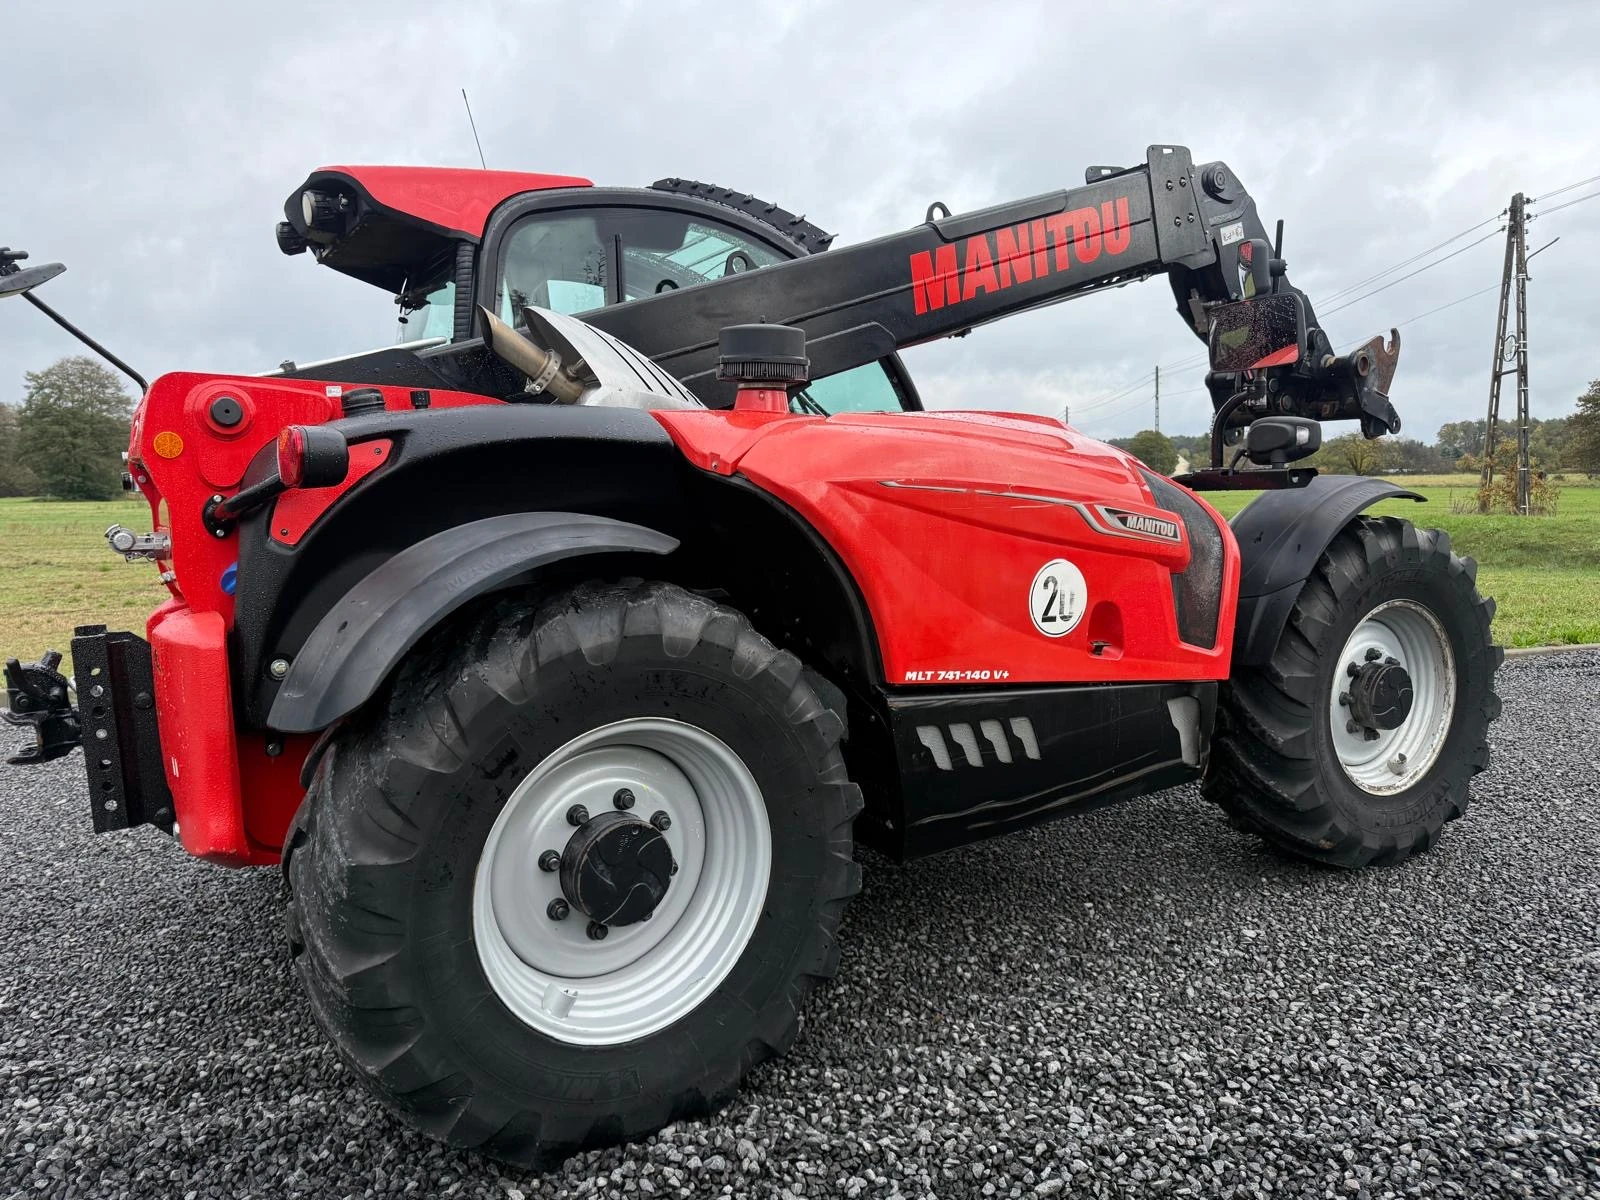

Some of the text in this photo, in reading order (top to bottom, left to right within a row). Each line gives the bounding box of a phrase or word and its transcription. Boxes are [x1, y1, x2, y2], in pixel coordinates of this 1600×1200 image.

[910, 196, 1132, 316] MANITOU
[1126, 515, 1175, 537] MANITOU
[904, 670, 1010, 681] MLT 741-140 V+
